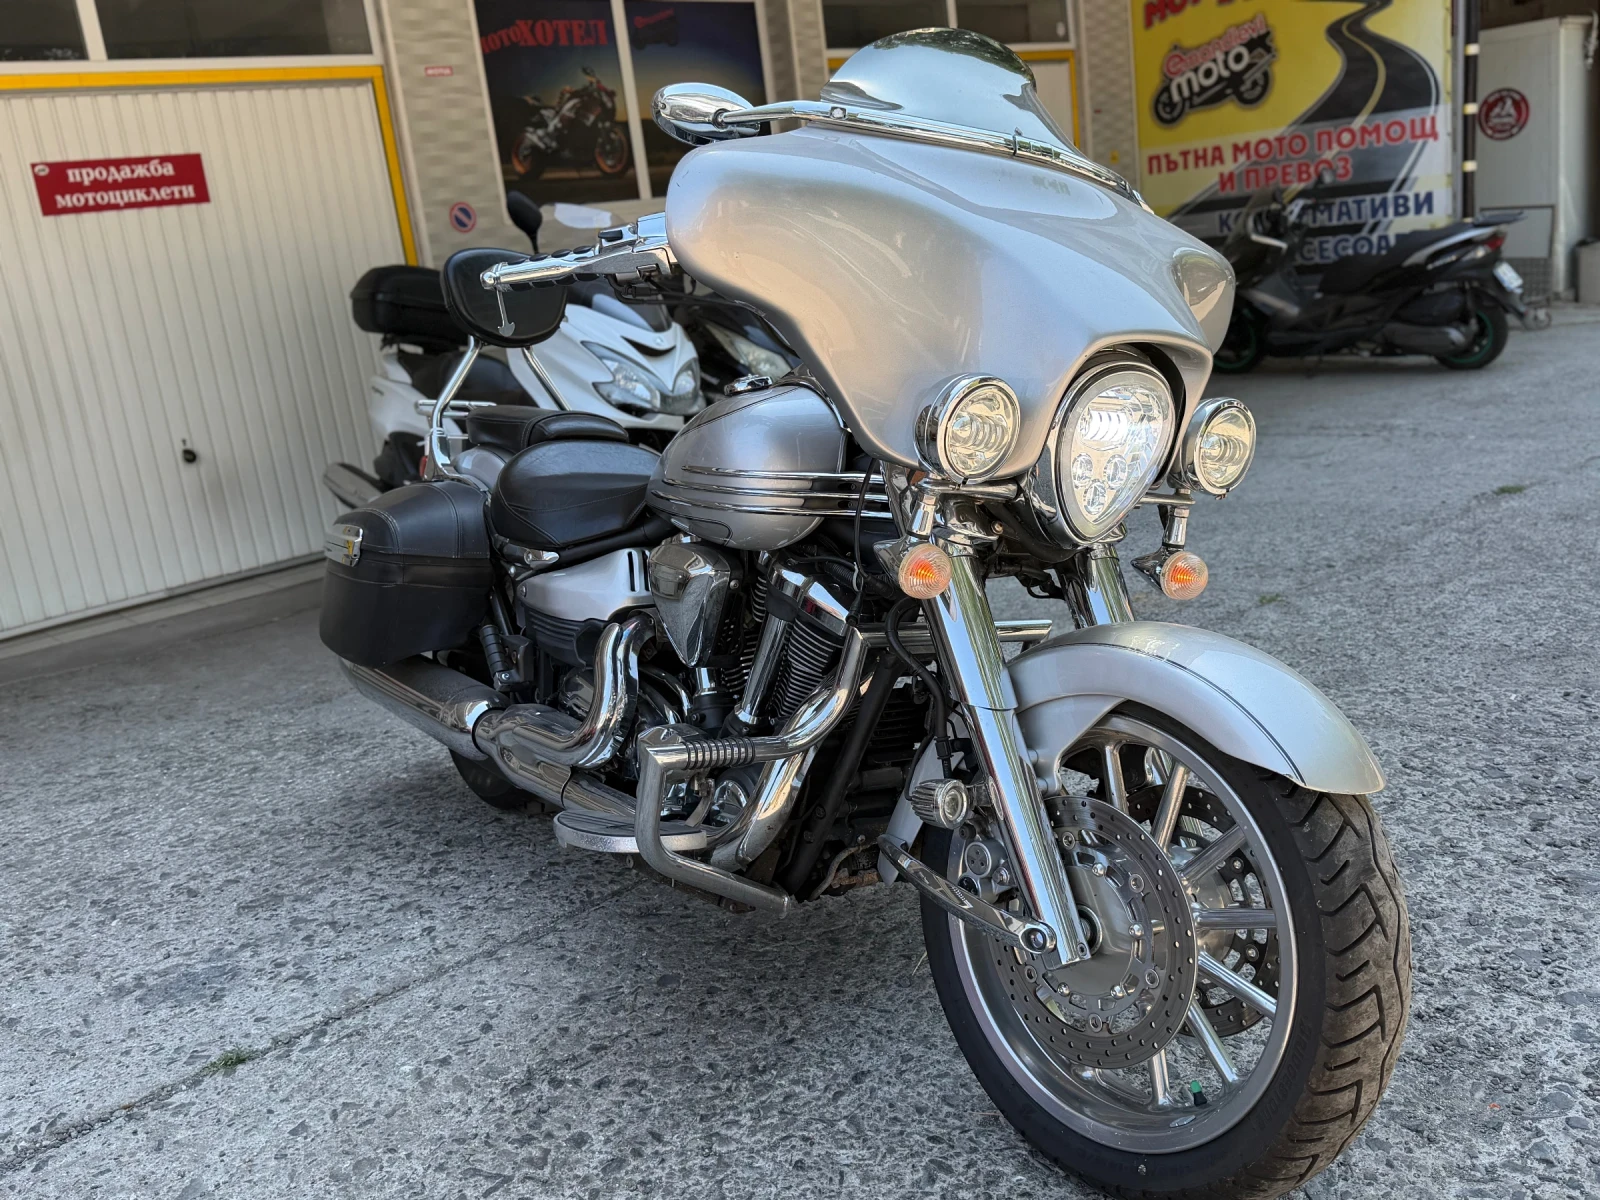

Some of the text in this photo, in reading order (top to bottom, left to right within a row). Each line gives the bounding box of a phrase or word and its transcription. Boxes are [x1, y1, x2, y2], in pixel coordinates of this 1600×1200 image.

[1170, 45, 1250, 103] moto
[1148, 116, 1439, 175] ПЪТНА МОТО ПОМОЩ
[66, 159, 175, 186] продажба
[1219, 157, 1352, 193] И ПРЕВОЗ
[55, 184, 196, 209] мотоциклети
